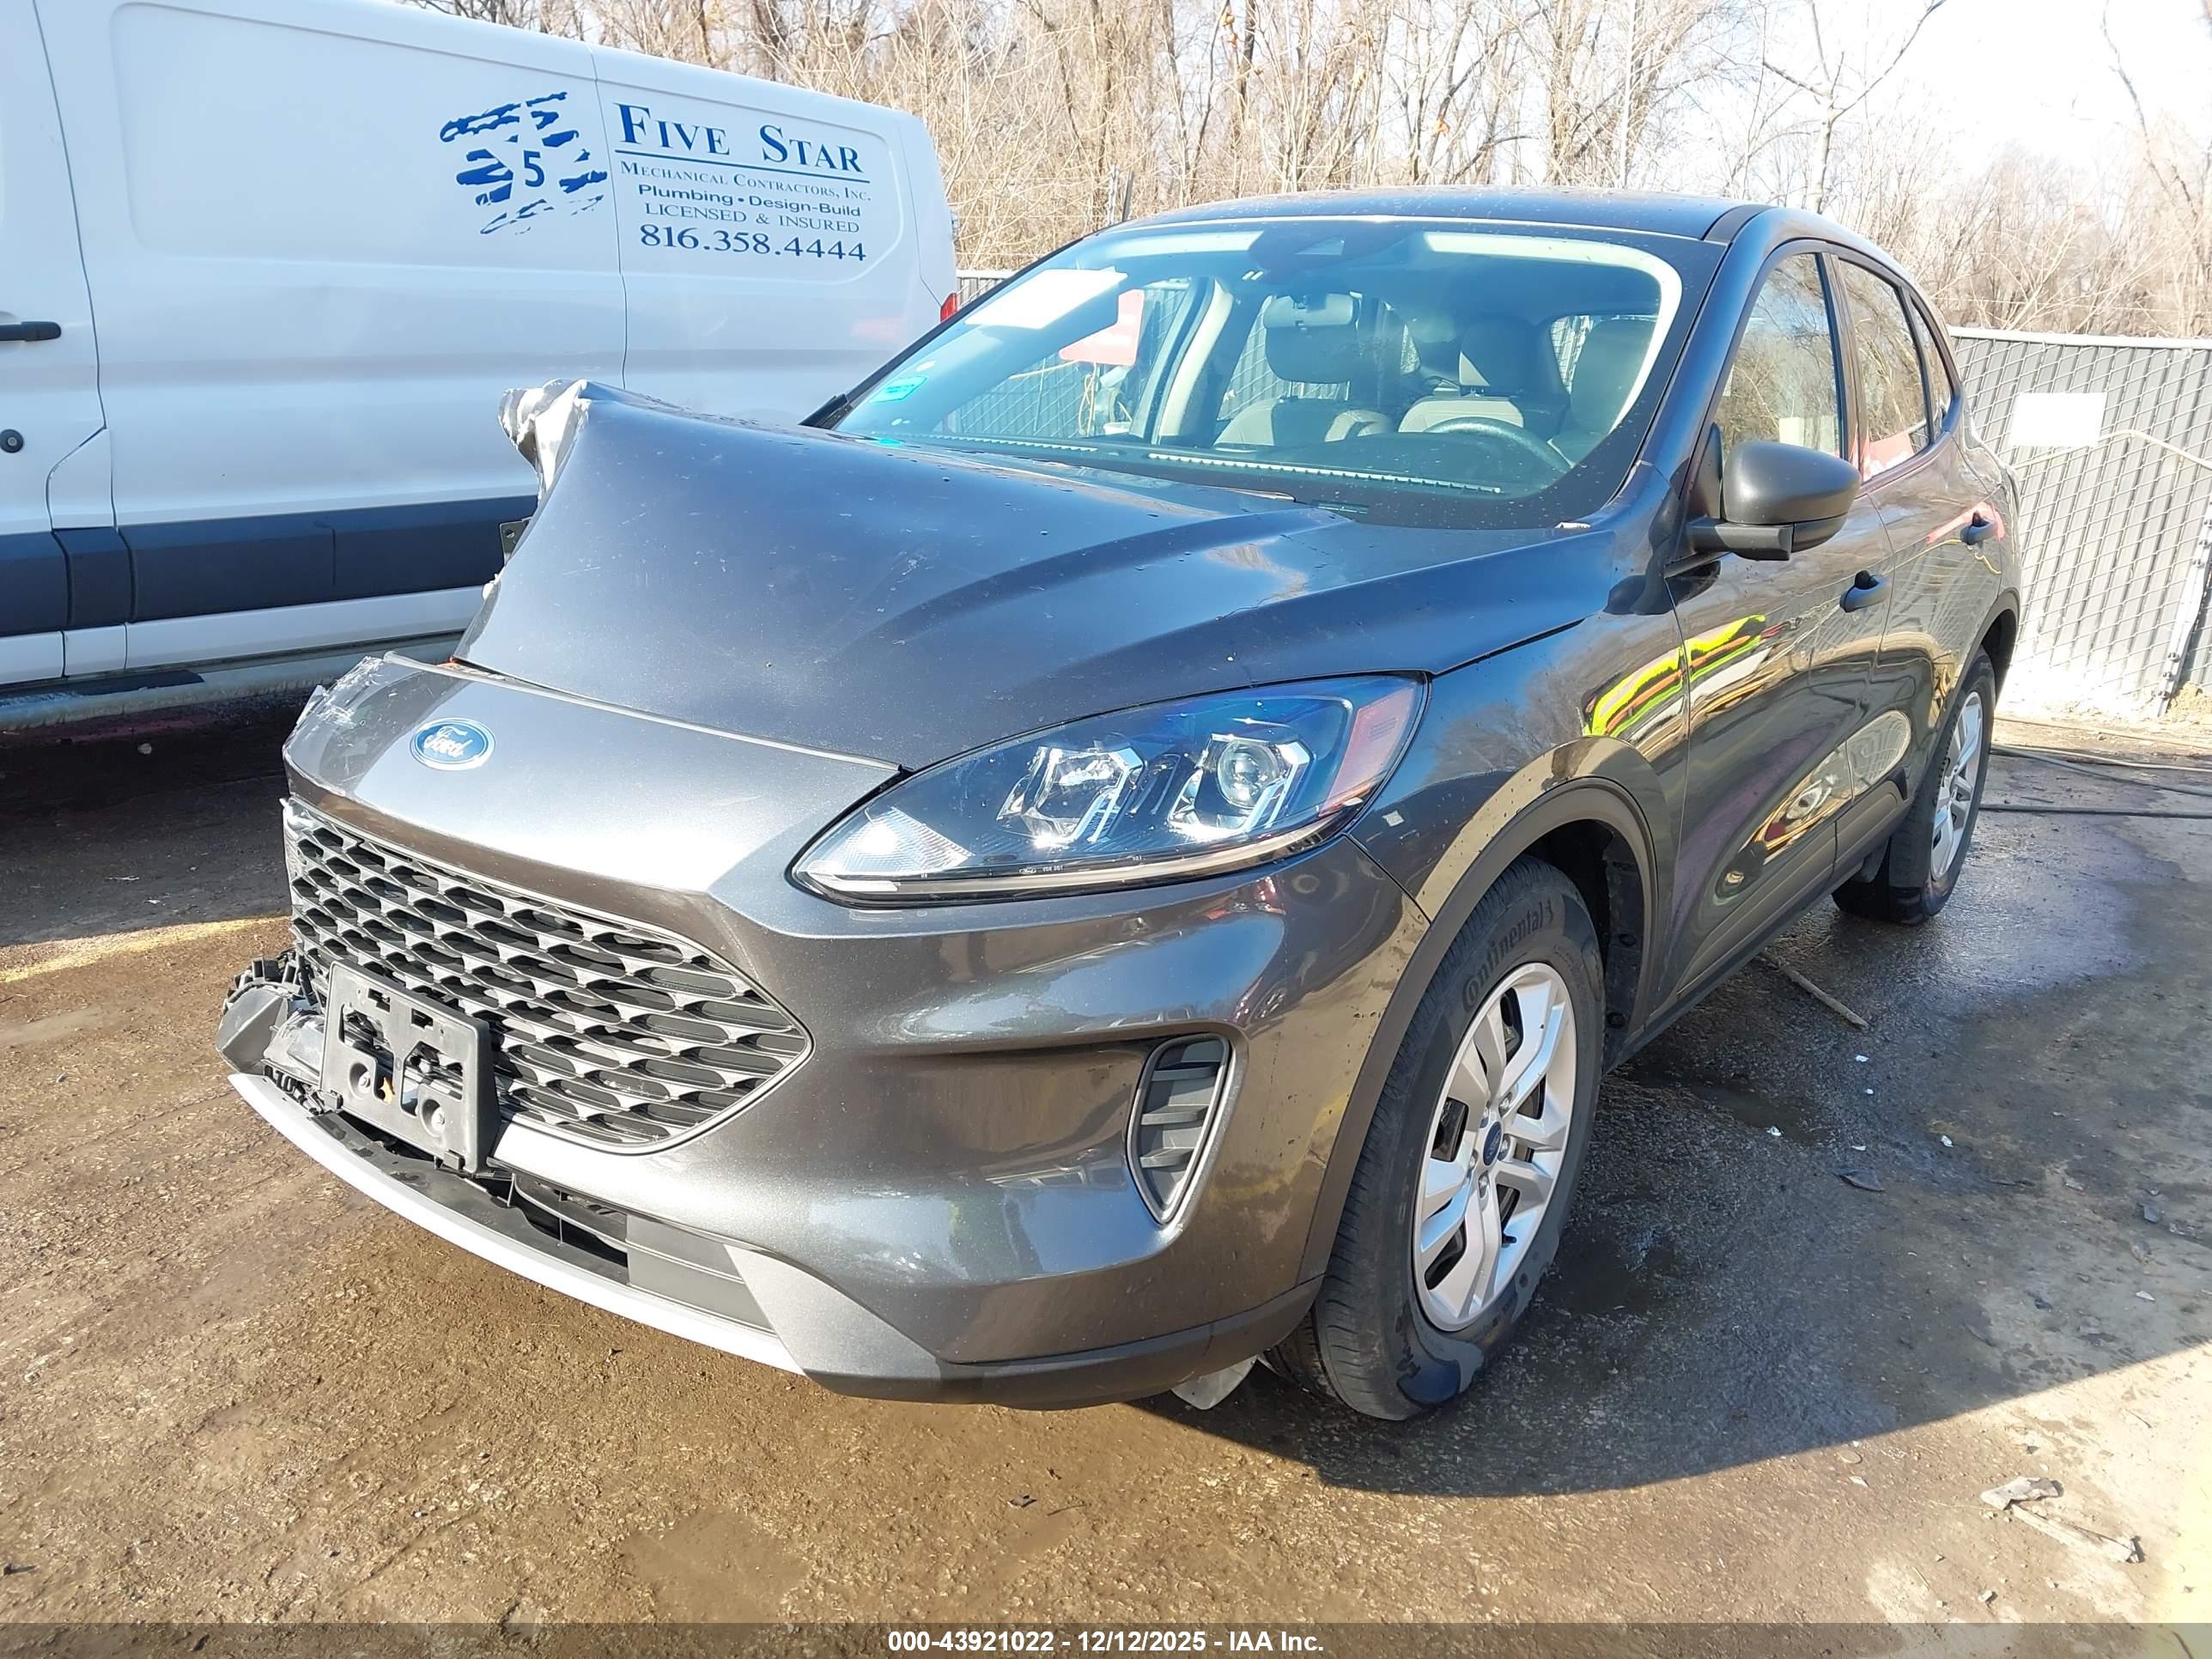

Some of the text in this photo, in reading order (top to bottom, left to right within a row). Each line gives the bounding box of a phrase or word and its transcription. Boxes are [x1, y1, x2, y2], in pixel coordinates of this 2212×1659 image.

[523, 150, 545, 187] 5
[645, 203, 860, 234] LICENSED & INSURED
[640, 223, 867, 262] 816.358.4444
[423, 726, 474, 757] Ford
